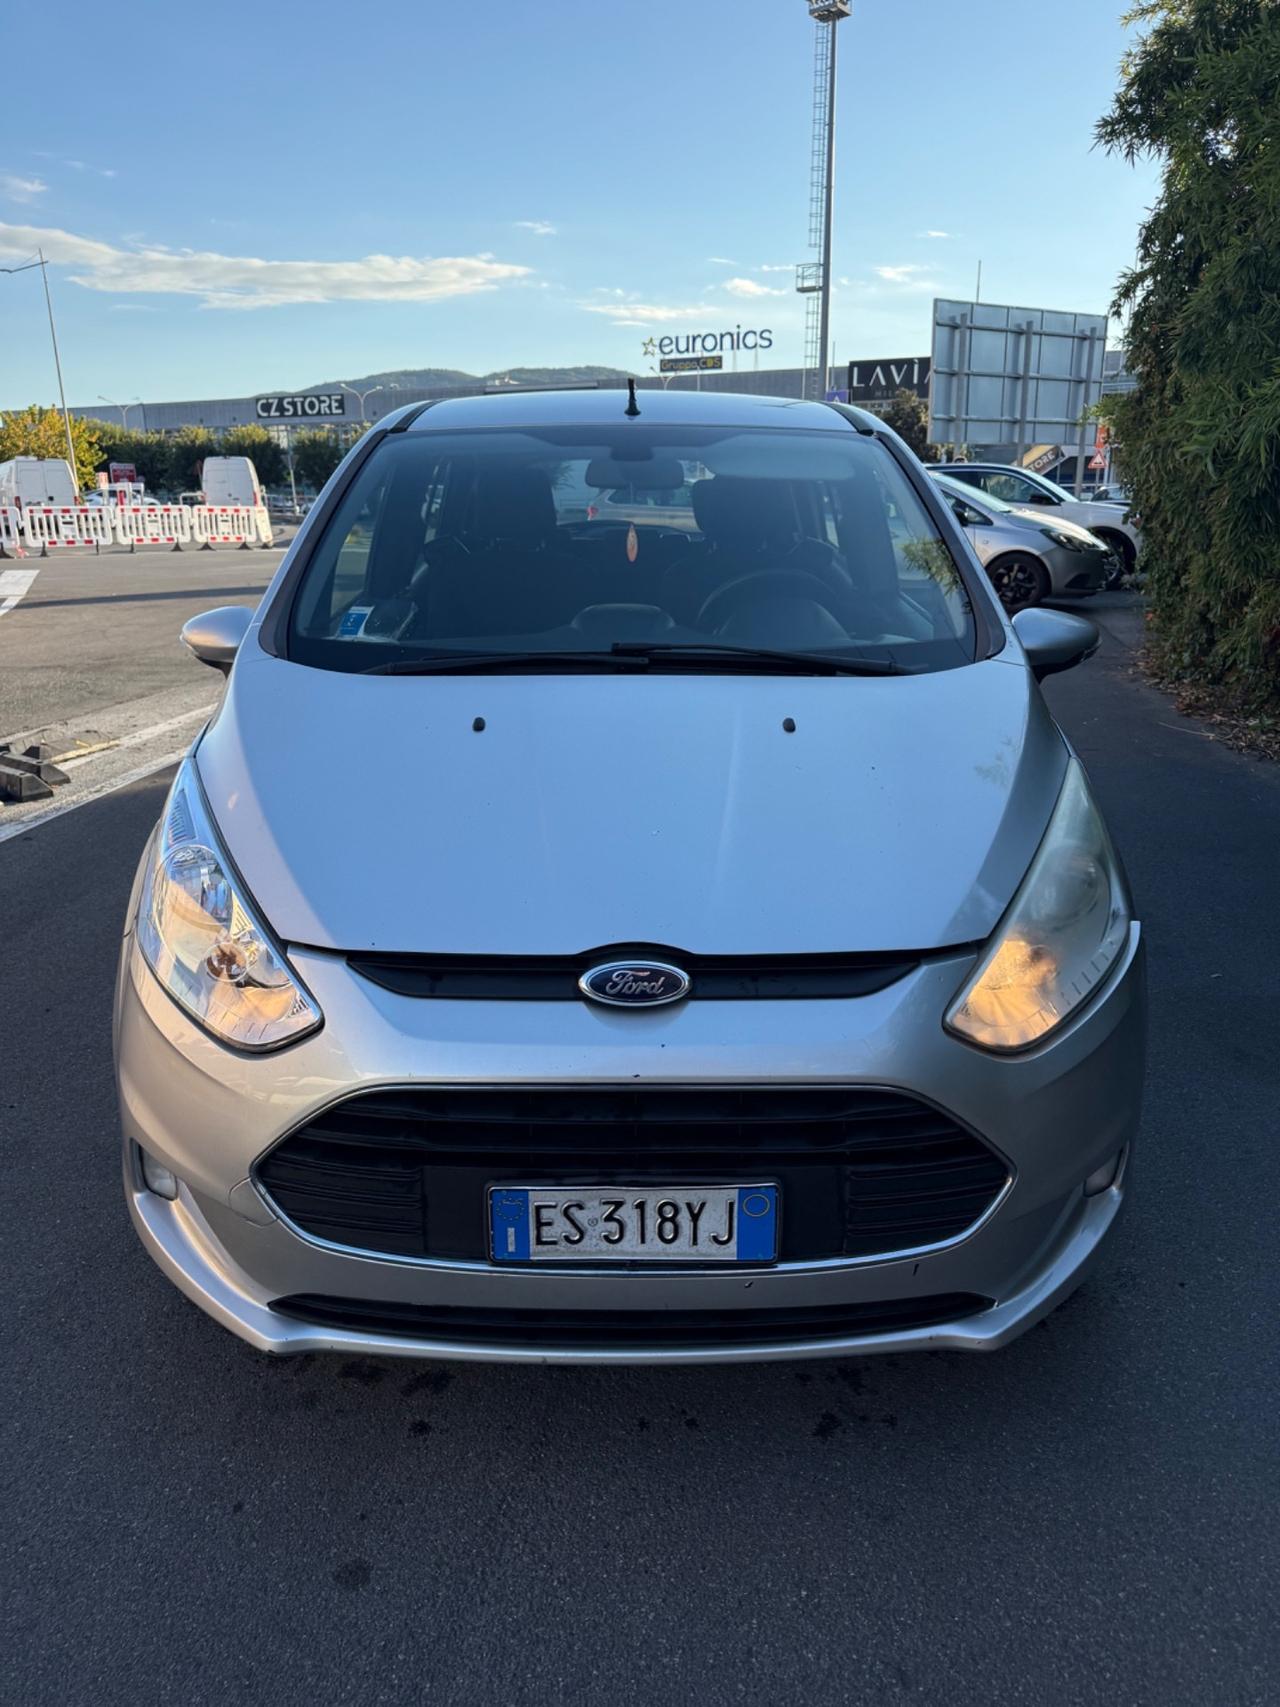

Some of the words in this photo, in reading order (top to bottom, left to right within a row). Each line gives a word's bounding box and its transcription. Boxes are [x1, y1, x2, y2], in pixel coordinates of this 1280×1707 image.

[658, 324, 773, 355] euronics
[257, 398, 280, 417] CZ
[283, 395, 343, 416] STORE
[1027, 450, 1056, 471] TORE
[605, 970, 666, 995] Ford
